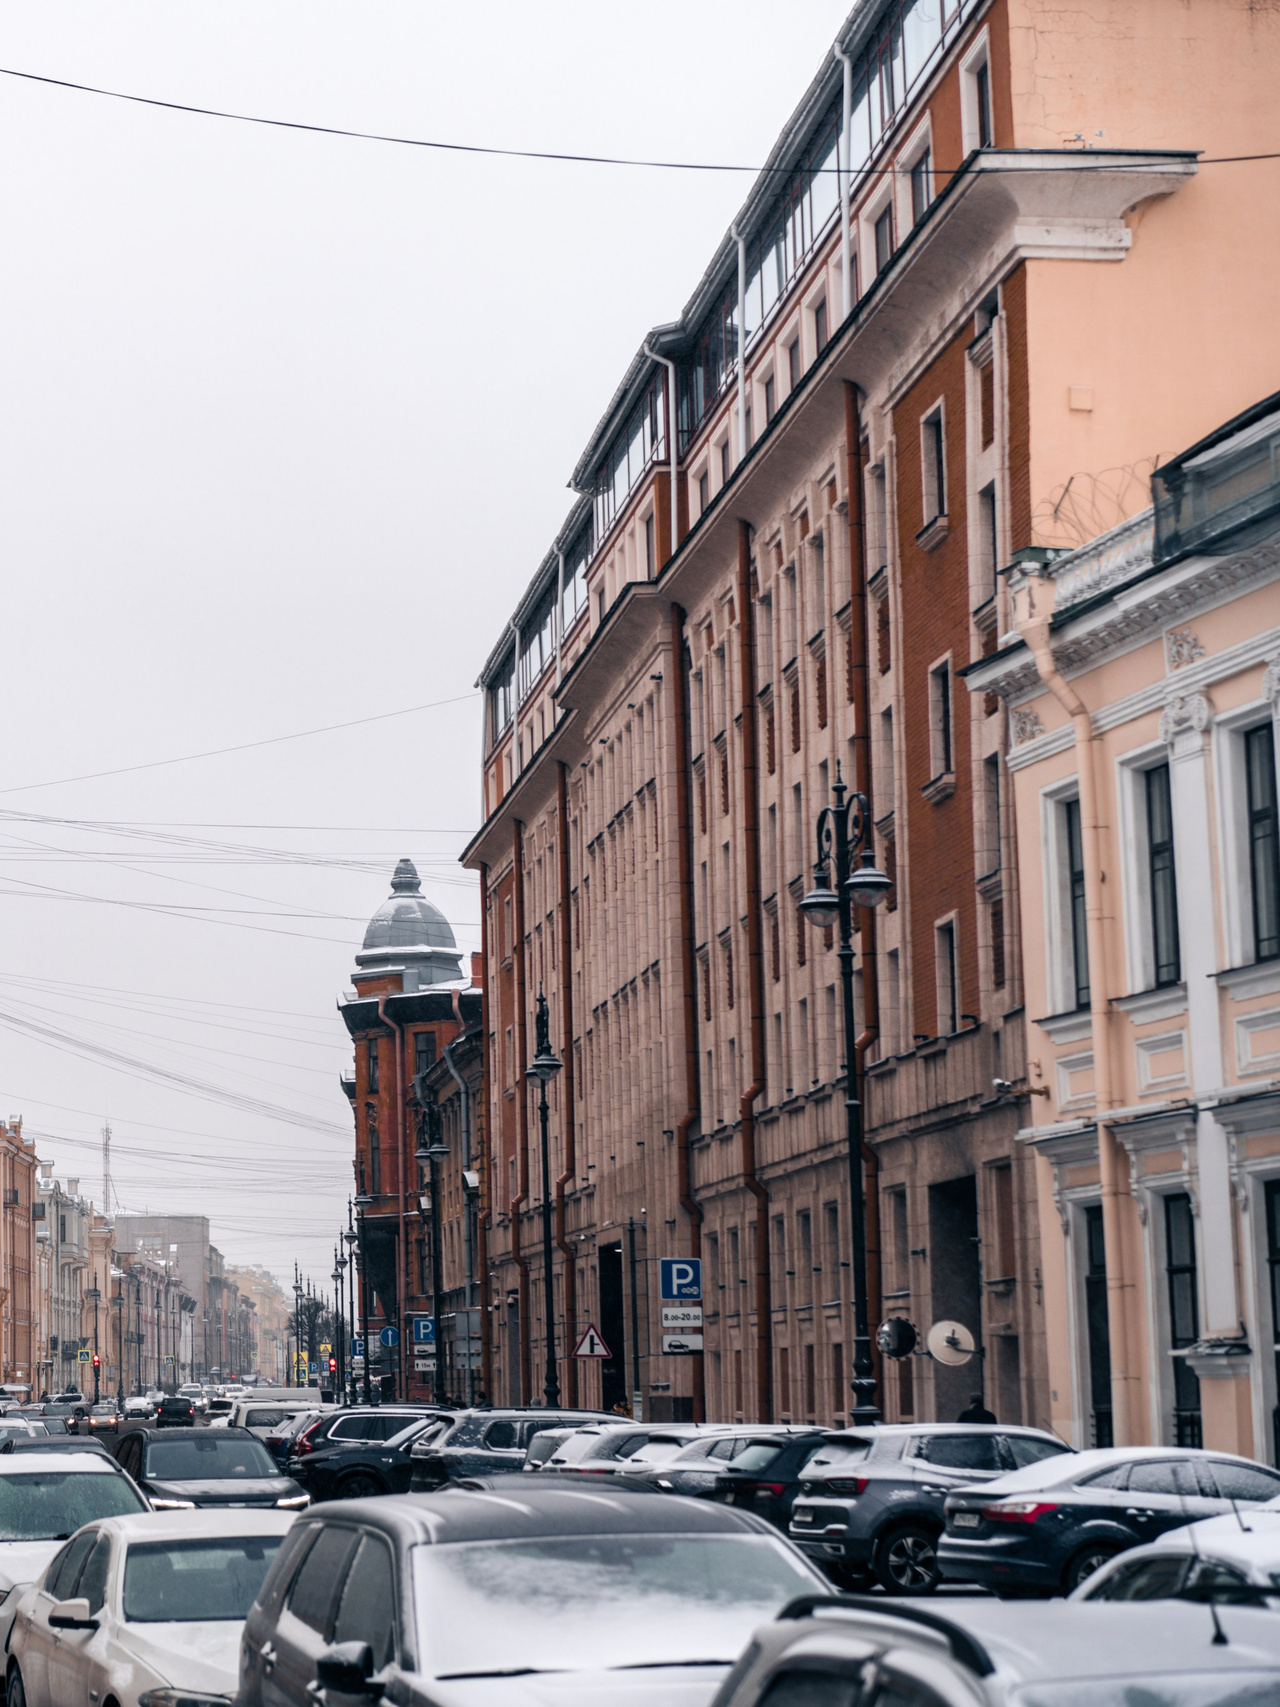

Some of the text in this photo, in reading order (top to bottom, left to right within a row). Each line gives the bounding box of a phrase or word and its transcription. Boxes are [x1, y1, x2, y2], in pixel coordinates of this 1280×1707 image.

[672, 1264, 694, 1295] P
[420, 1321, 432, 1339] P
[356, 1341, 364, 1354] P
[311, 1363, 317, 1372] P
